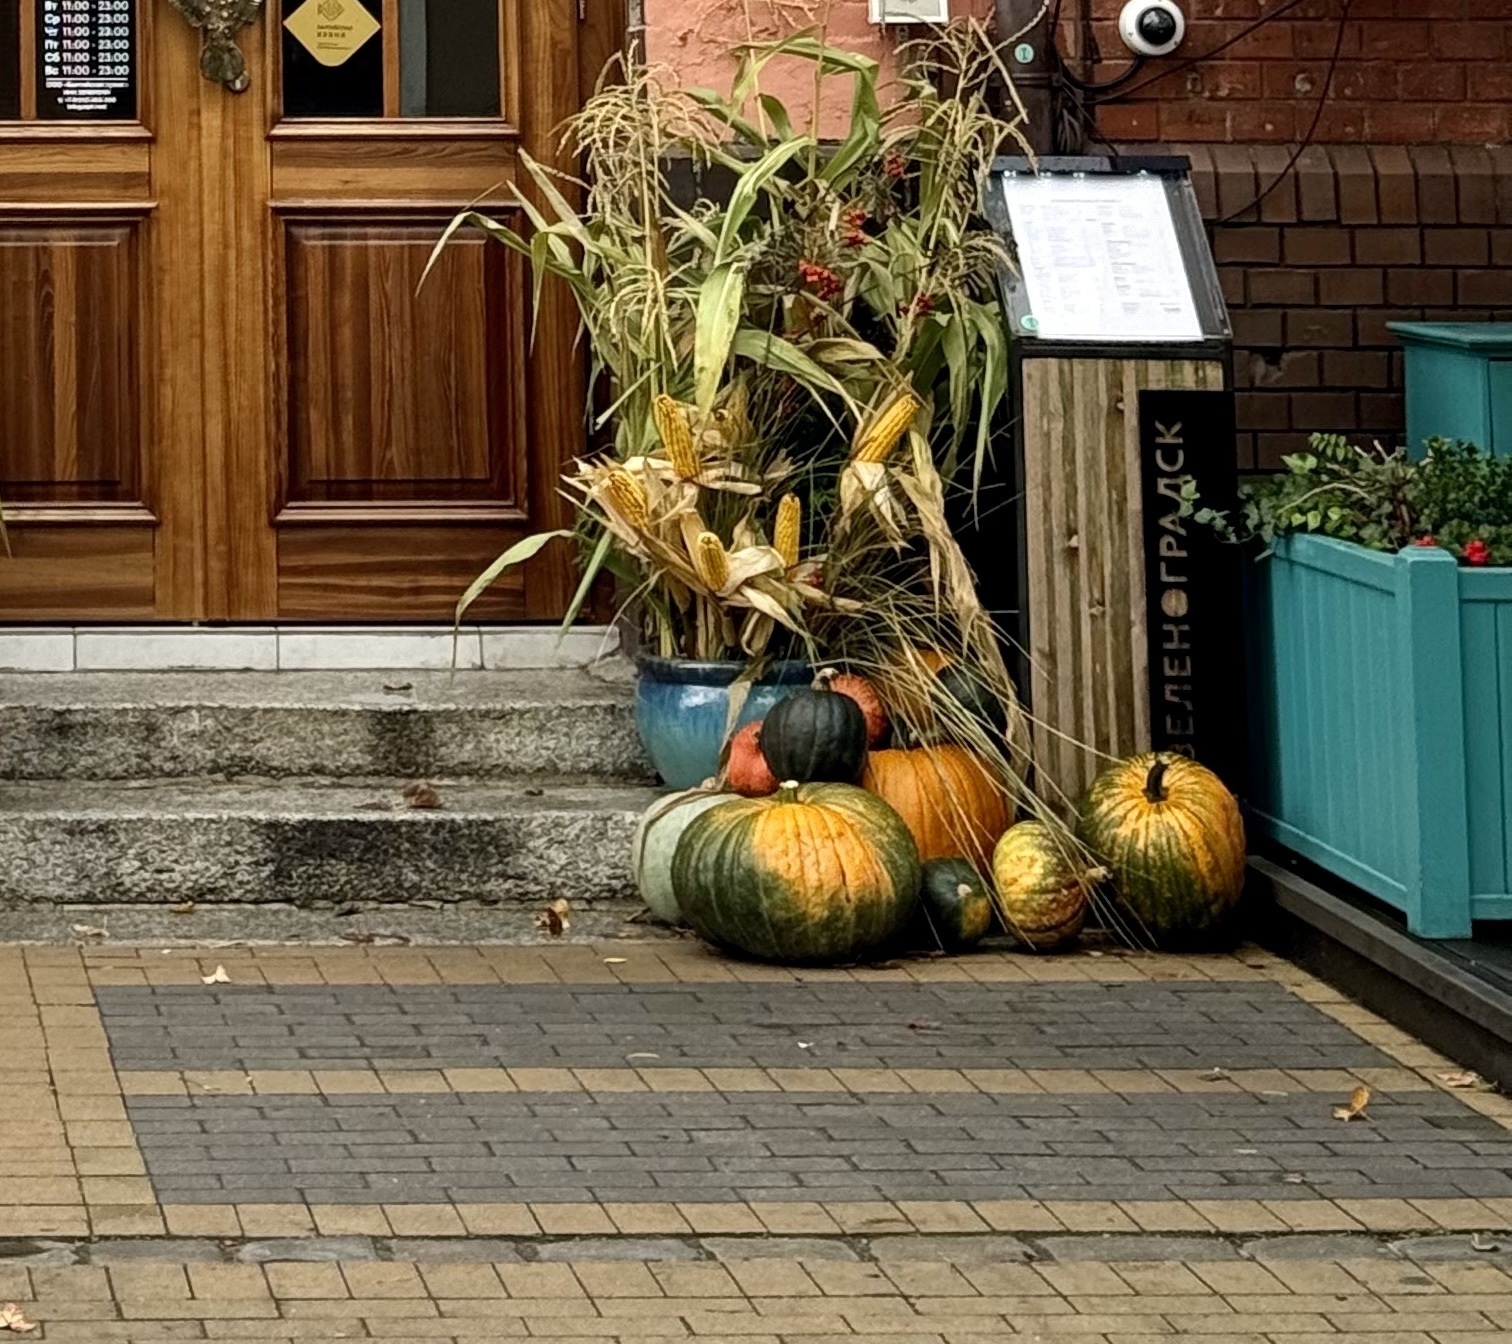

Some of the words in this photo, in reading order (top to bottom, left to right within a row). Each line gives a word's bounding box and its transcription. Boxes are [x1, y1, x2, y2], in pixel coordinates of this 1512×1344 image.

[62, 0, 90, 12] 11:00
[97, 0, 129, 12] 23:00
[62, 13, 90, 24] 11:00
[97, 13, 129, 24] 23:00
[62, 26, 90, 37] 11:00
[97, 26, 129, 37] 23:00
[62, 39, 90, 50] 11:00
[97, 39, 129, 50] 23:00
[62, 51, 90, 63] 11:00
[97, 51, 129, 63] 23:00
[62, 65, 90, 76] 11:00
[97, 65, 129, 76] 23:00
